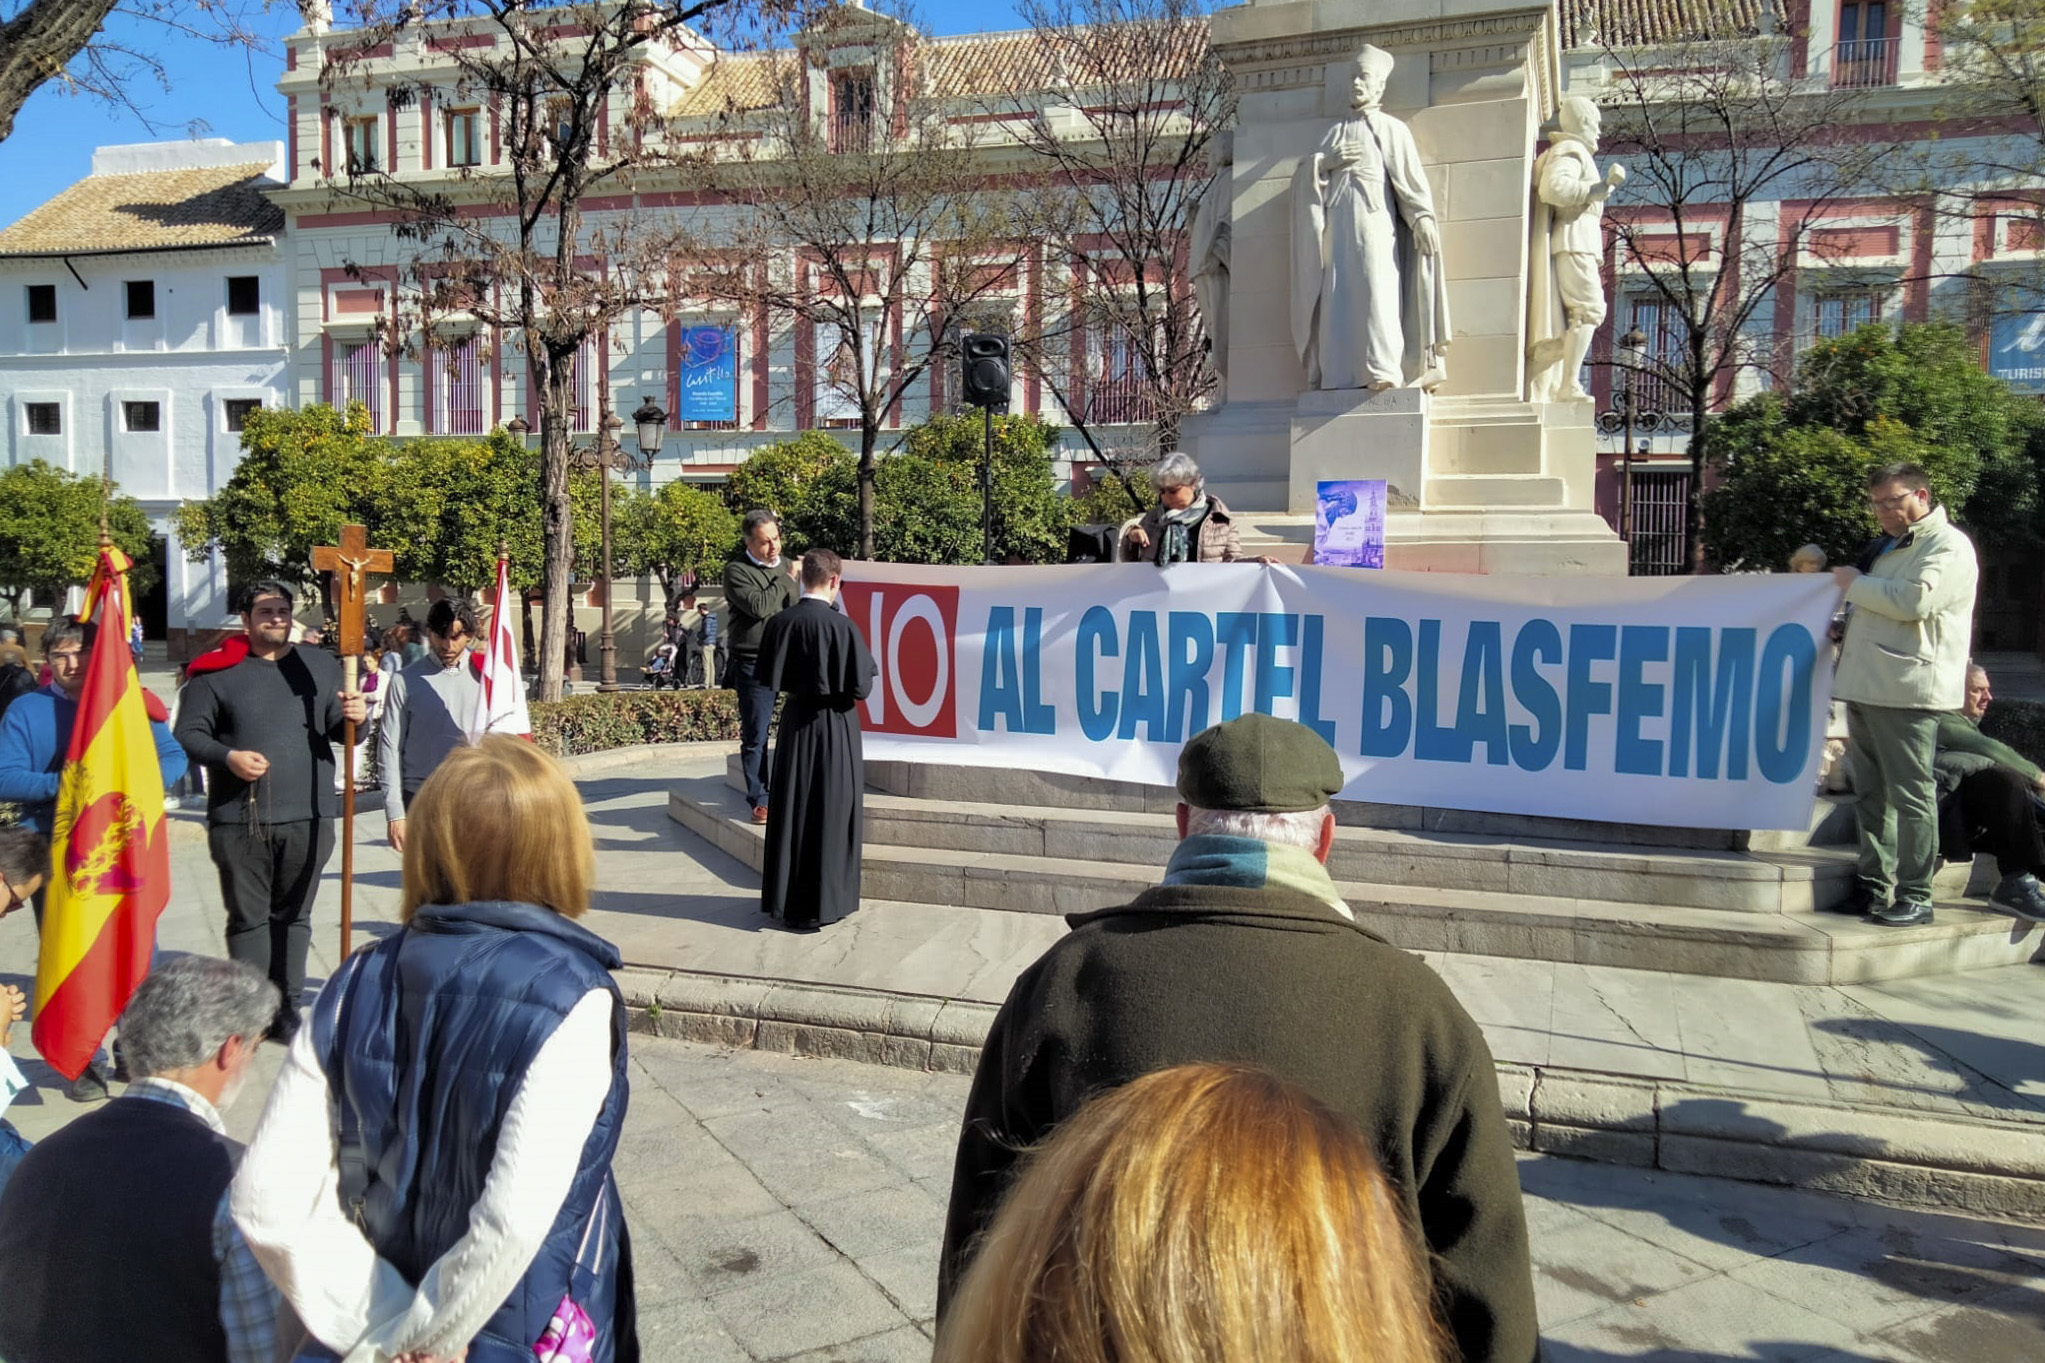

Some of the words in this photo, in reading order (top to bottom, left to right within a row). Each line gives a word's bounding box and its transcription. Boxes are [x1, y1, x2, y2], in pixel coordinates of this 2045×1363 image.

[1998, 367, 2045, 379] TURIS
[977, 606, 1056, 735] AL
[1075, 605, 1336, 749] CARTEL
[1360, 616, 1817, 784] BLASFEMO
